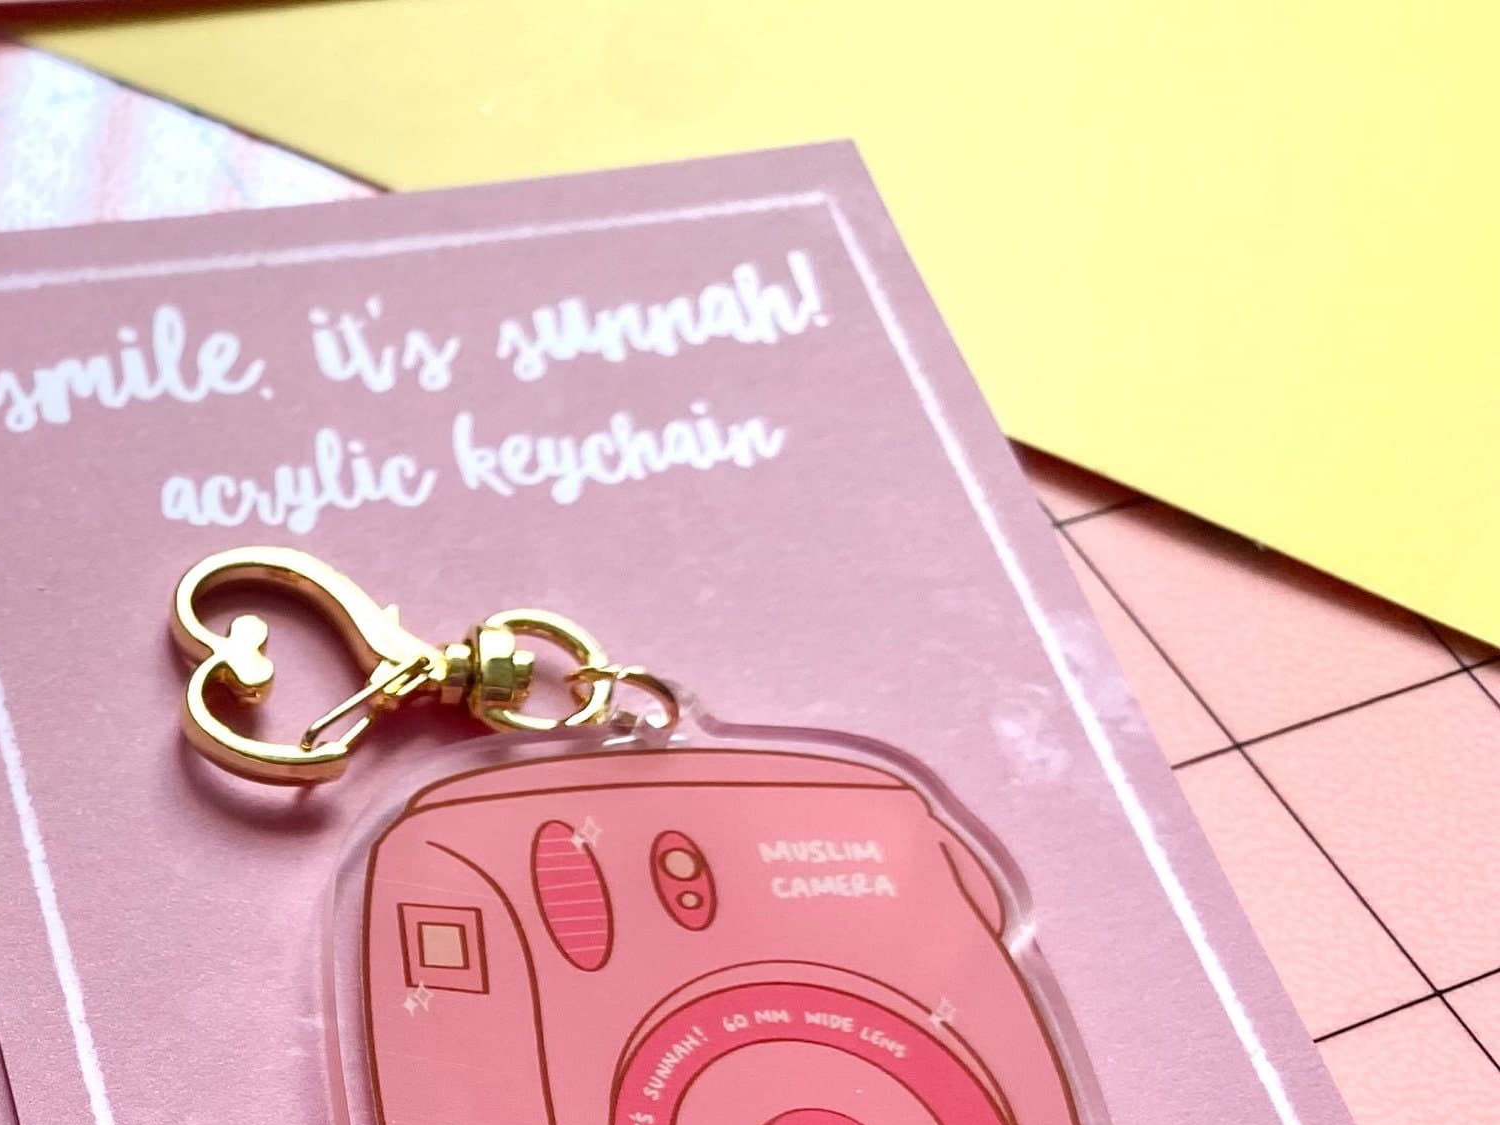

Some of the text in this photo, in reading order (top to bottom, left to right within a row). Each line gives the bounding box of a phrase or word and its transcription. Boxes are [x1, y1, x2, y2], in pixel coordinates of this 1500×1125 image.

[310, 298, 460, 392] it's
[498, 251, 829, 380] sunnah!
[161, 401, 785, 534] acrylic keychain
[757, 840, 884, 864] MUSLIM
[771, 873, 897, 899] CAMERA
[643, 1025, 709, 1102] SUNNAH!
[722, 1013, 750, 1033] 60
[754, 1008, 791, 1025] MM
[804, 1010, 855, 1033] WIDE
[860, 1025, 907, 1060] LENS
